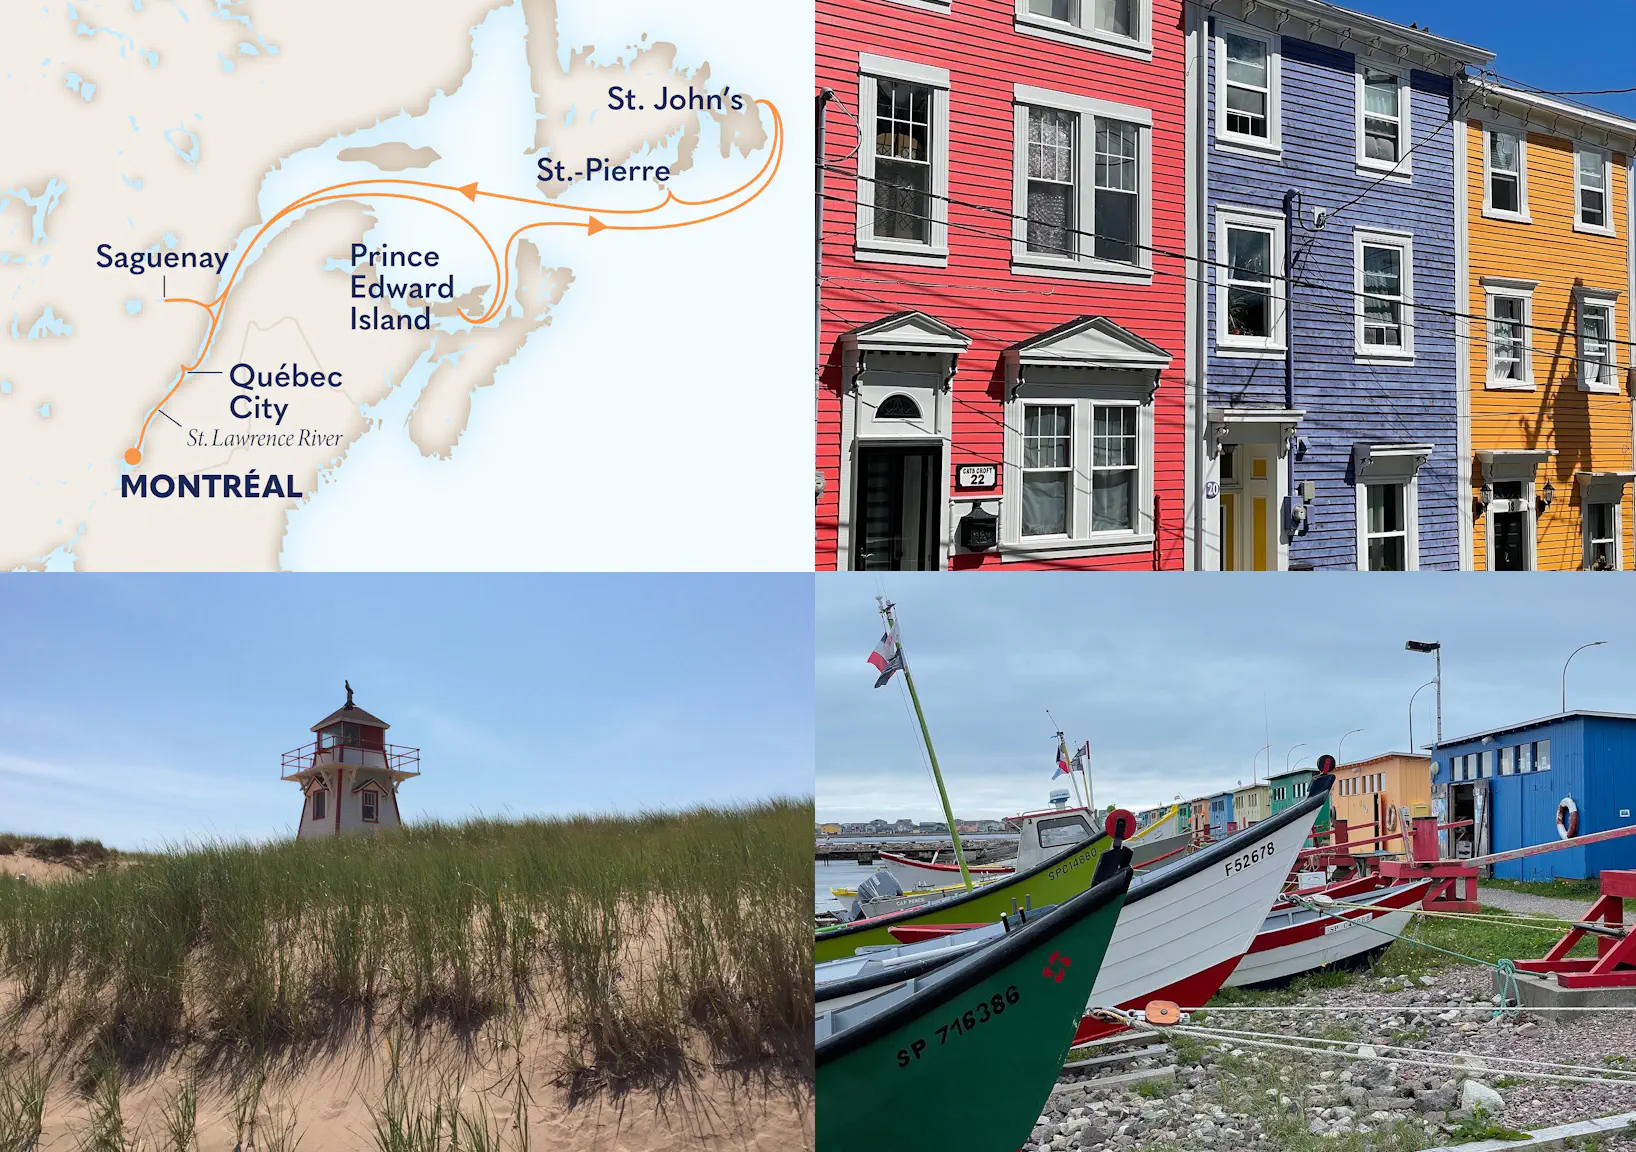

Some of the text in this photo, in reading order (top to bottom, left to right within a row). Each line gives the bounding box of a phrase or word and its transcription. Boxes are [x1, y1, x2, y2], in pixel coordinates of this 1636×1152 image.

[608, 86, 645, 111] St.
[537, 158, 671, 182] St.-Pierre
[96, 244, 229, 274] Saguenay
[351, 244, 440, 267] Prince
[351, 275, 454, 299] Edward
[351, 306, 430, 331] Island
[229, 363, 343, 390] Québec
[229, 395, 289, 425] City
[186, 428, 344, 447] St. Lawrence River
[121, 469, 303, 498] MONTRÉAL
[970, 475, 985, 485] 22
[1207, 483, 1218, 496] 20
[1508, 502, 1515, 511] 18
[1048, 847, 1097, 881] SPC14680
[1225, 841, 1275, 877] F52678
[897, 985, 1020, 1068] SP 716386
